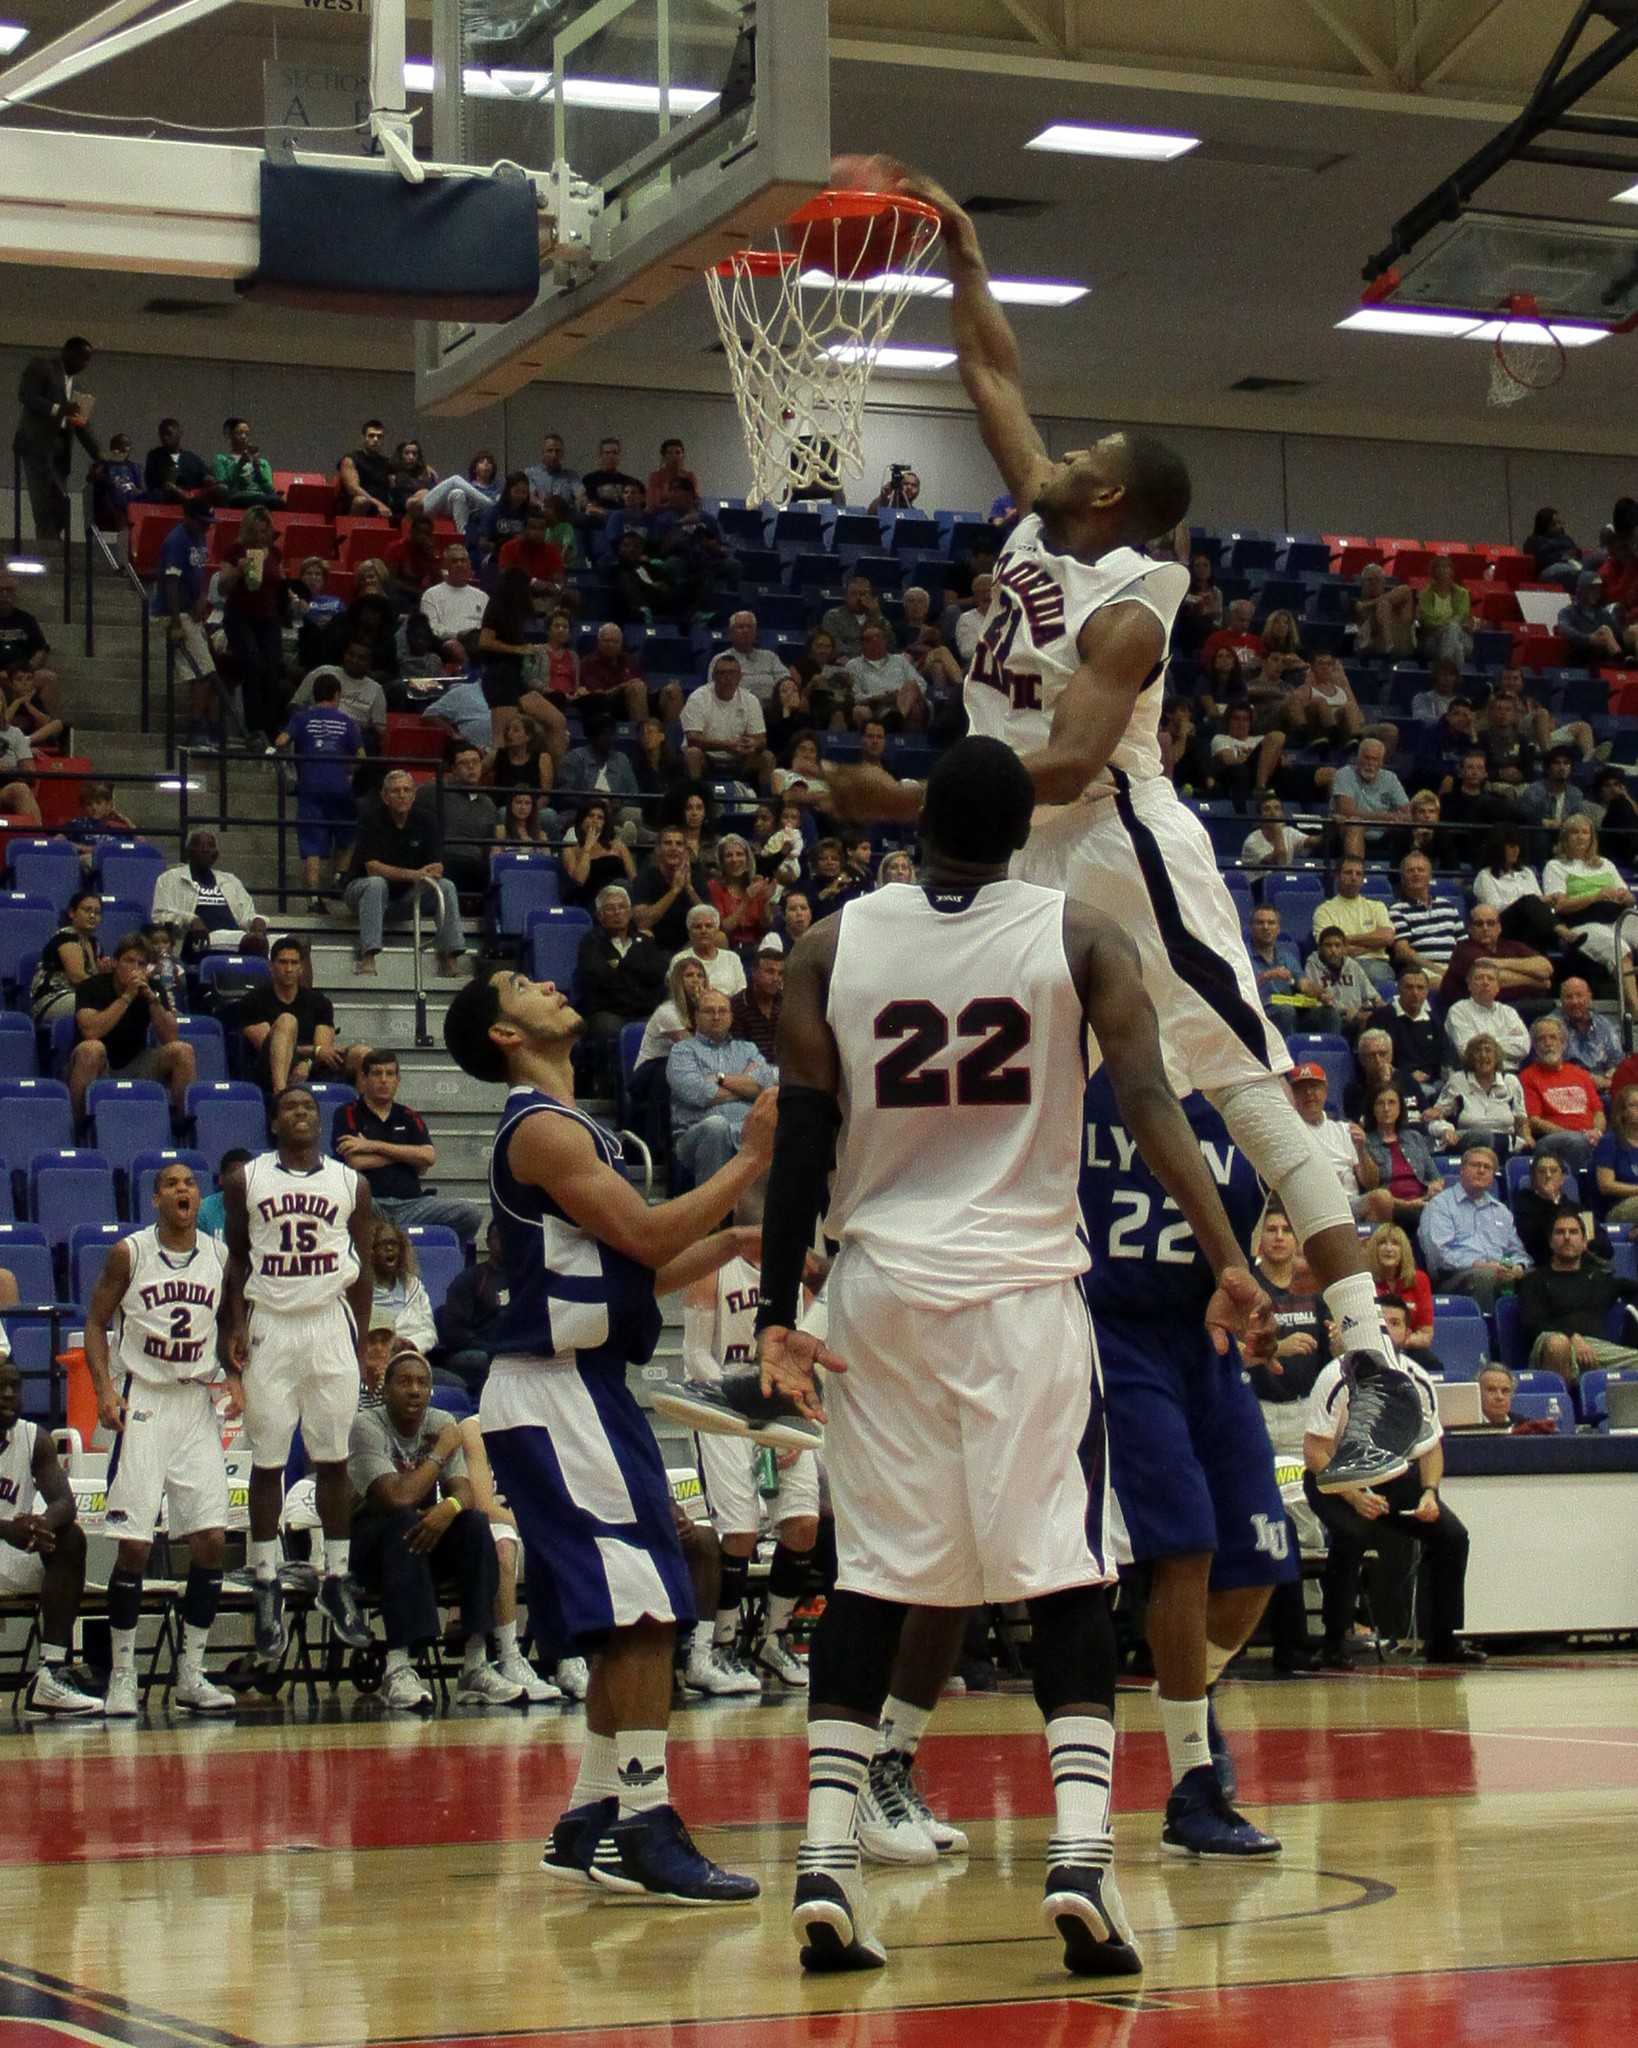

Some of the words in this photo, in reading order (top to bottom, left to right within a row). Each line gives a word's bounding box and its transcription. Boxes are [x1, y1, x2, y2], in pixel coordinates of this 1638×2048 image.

[874, 997, 1031, 1108] 22
[257, 1193, 339, 1226] FLORIDA
[280, 1220, 318, 1252] 15
[1109, 1190, 1199, 1263] 22
[260, 1252, 339, 1277] ATLANTIC
[139, 1280, 215, 1311] FLORIDA
[170, 1306, 191, 1338] 2
